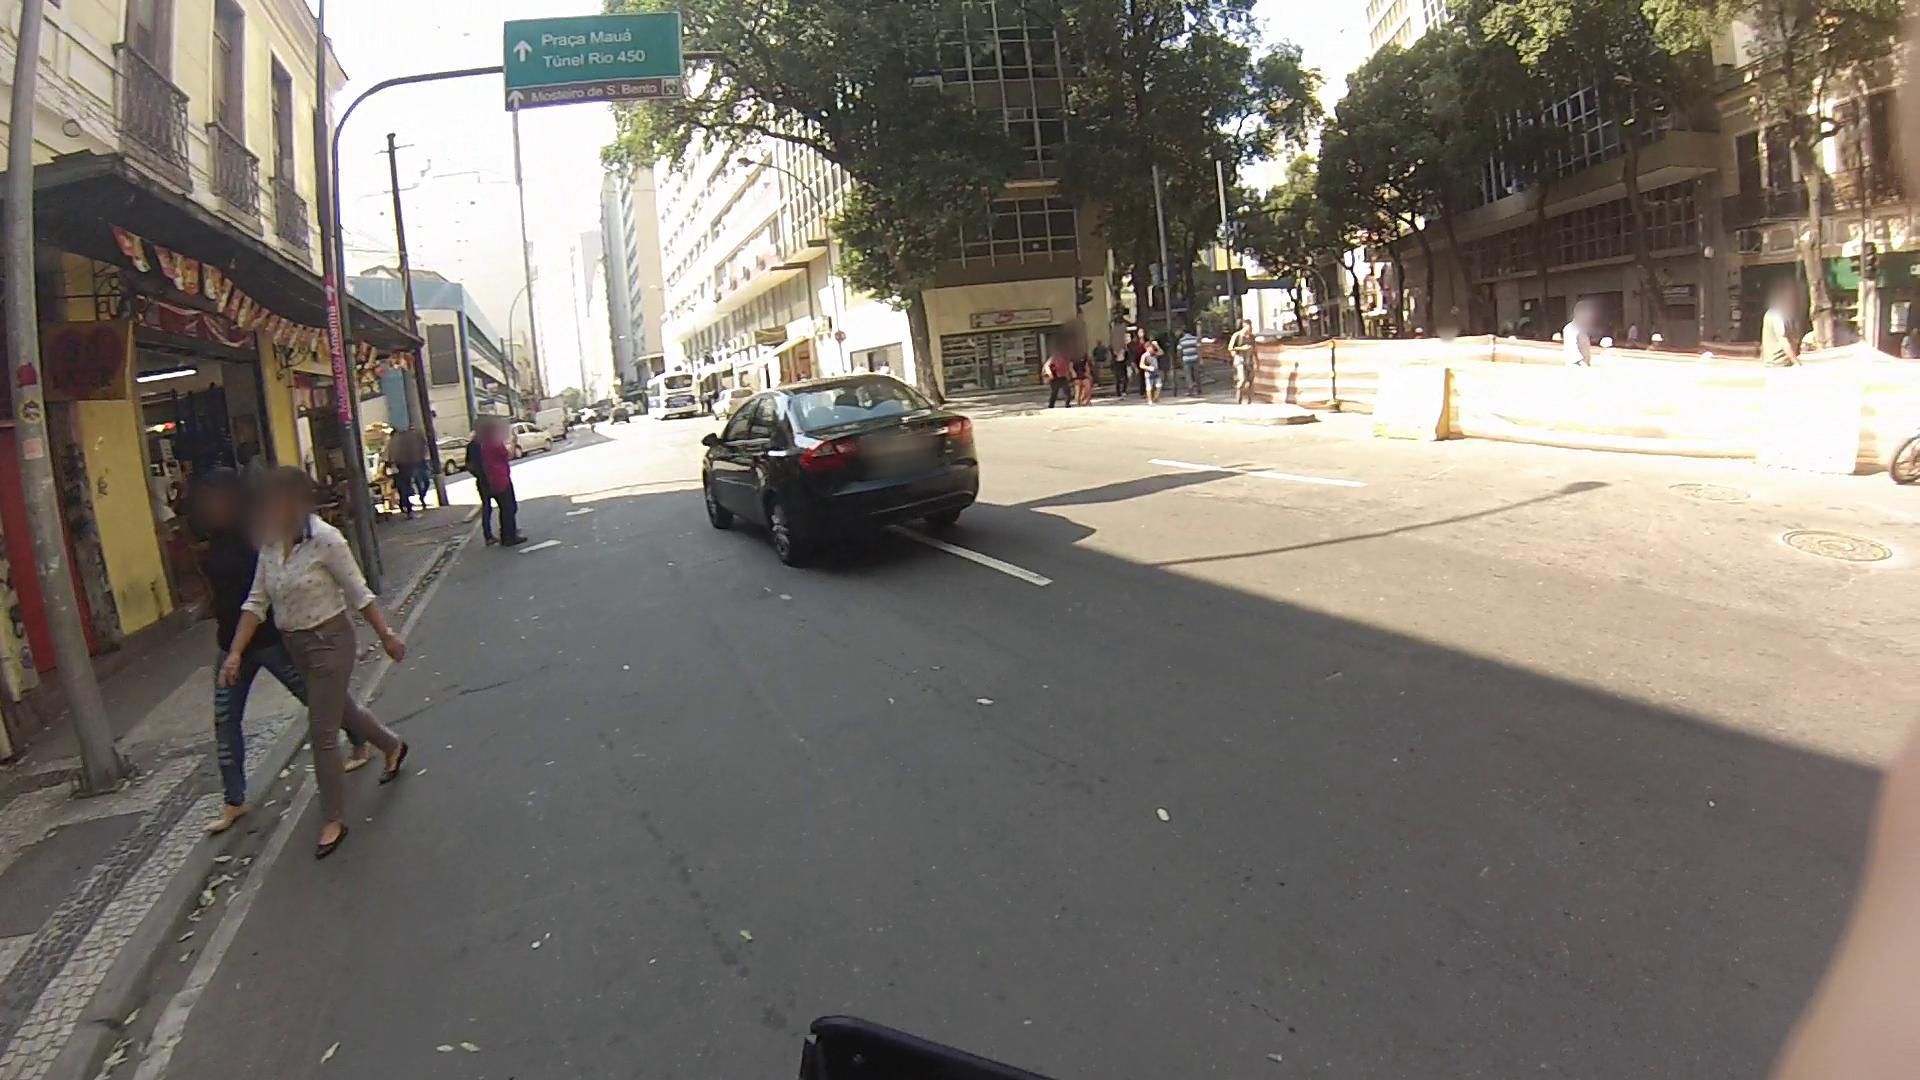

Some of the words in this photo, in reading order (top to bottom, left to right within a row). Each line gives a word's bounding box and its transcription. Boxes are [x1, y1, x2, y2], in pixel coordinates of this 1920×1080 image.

[541, 33, 586, 47] Praça
[590, 28, 632, 43] Mauá
[542, 53, 585, 68] Túnel
[588, 51, 614, 65] Rio
[617, 49, 646, 63] 450
[531, 88, 584, 102] Mosteiro
[587, 87, 604, 97] de
[622, 83, 658, 94] Bento
